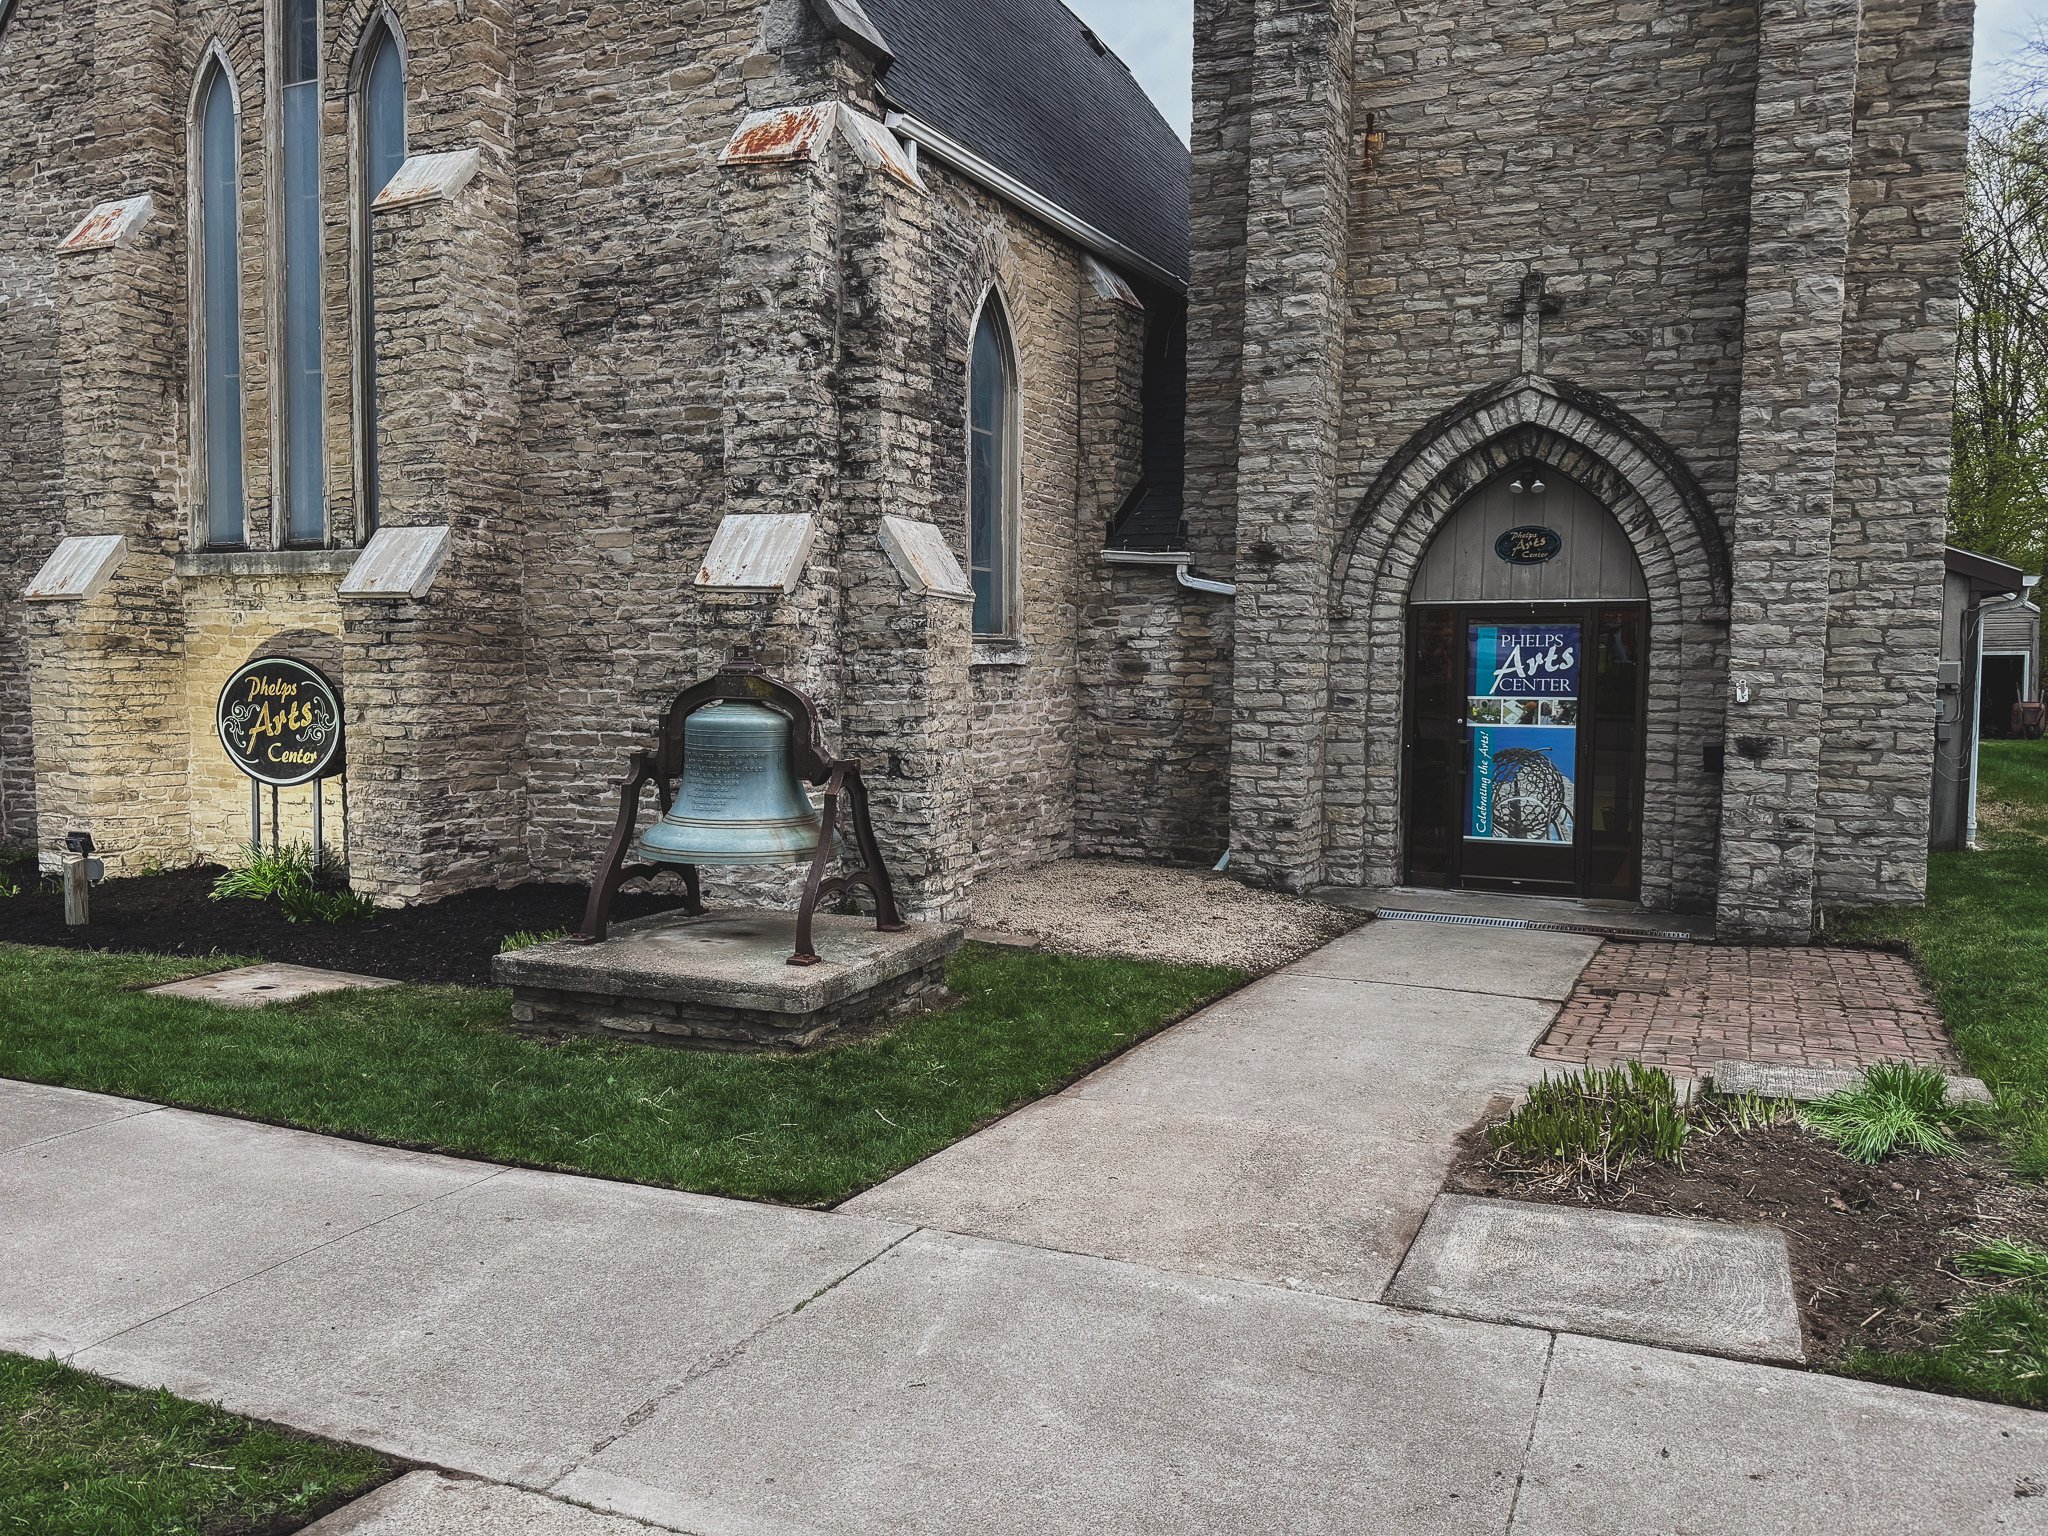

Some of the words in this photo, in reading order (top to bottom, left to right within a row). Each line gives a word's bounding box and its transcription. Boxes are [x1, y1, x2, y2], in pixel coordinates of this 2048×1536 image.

[1510, 531, 1537, 541] Phelps
[1511, 537, 1546, 556] Arts
[1501, 634, 1563, 647] PHELPS
[1489, 644, 1574, 694] Arts
[245, 676, 297, 703] Phelps
[1500, 678, 1571, 691] CENTER
[246, 701, 313, 754] Arts
[268, 743, 317, 764] Center
[1478, 731, 1492, 759] Arts!
[1477, 760, 1488, 775] the
[1476, 778, 1491, 833] Celebrating
